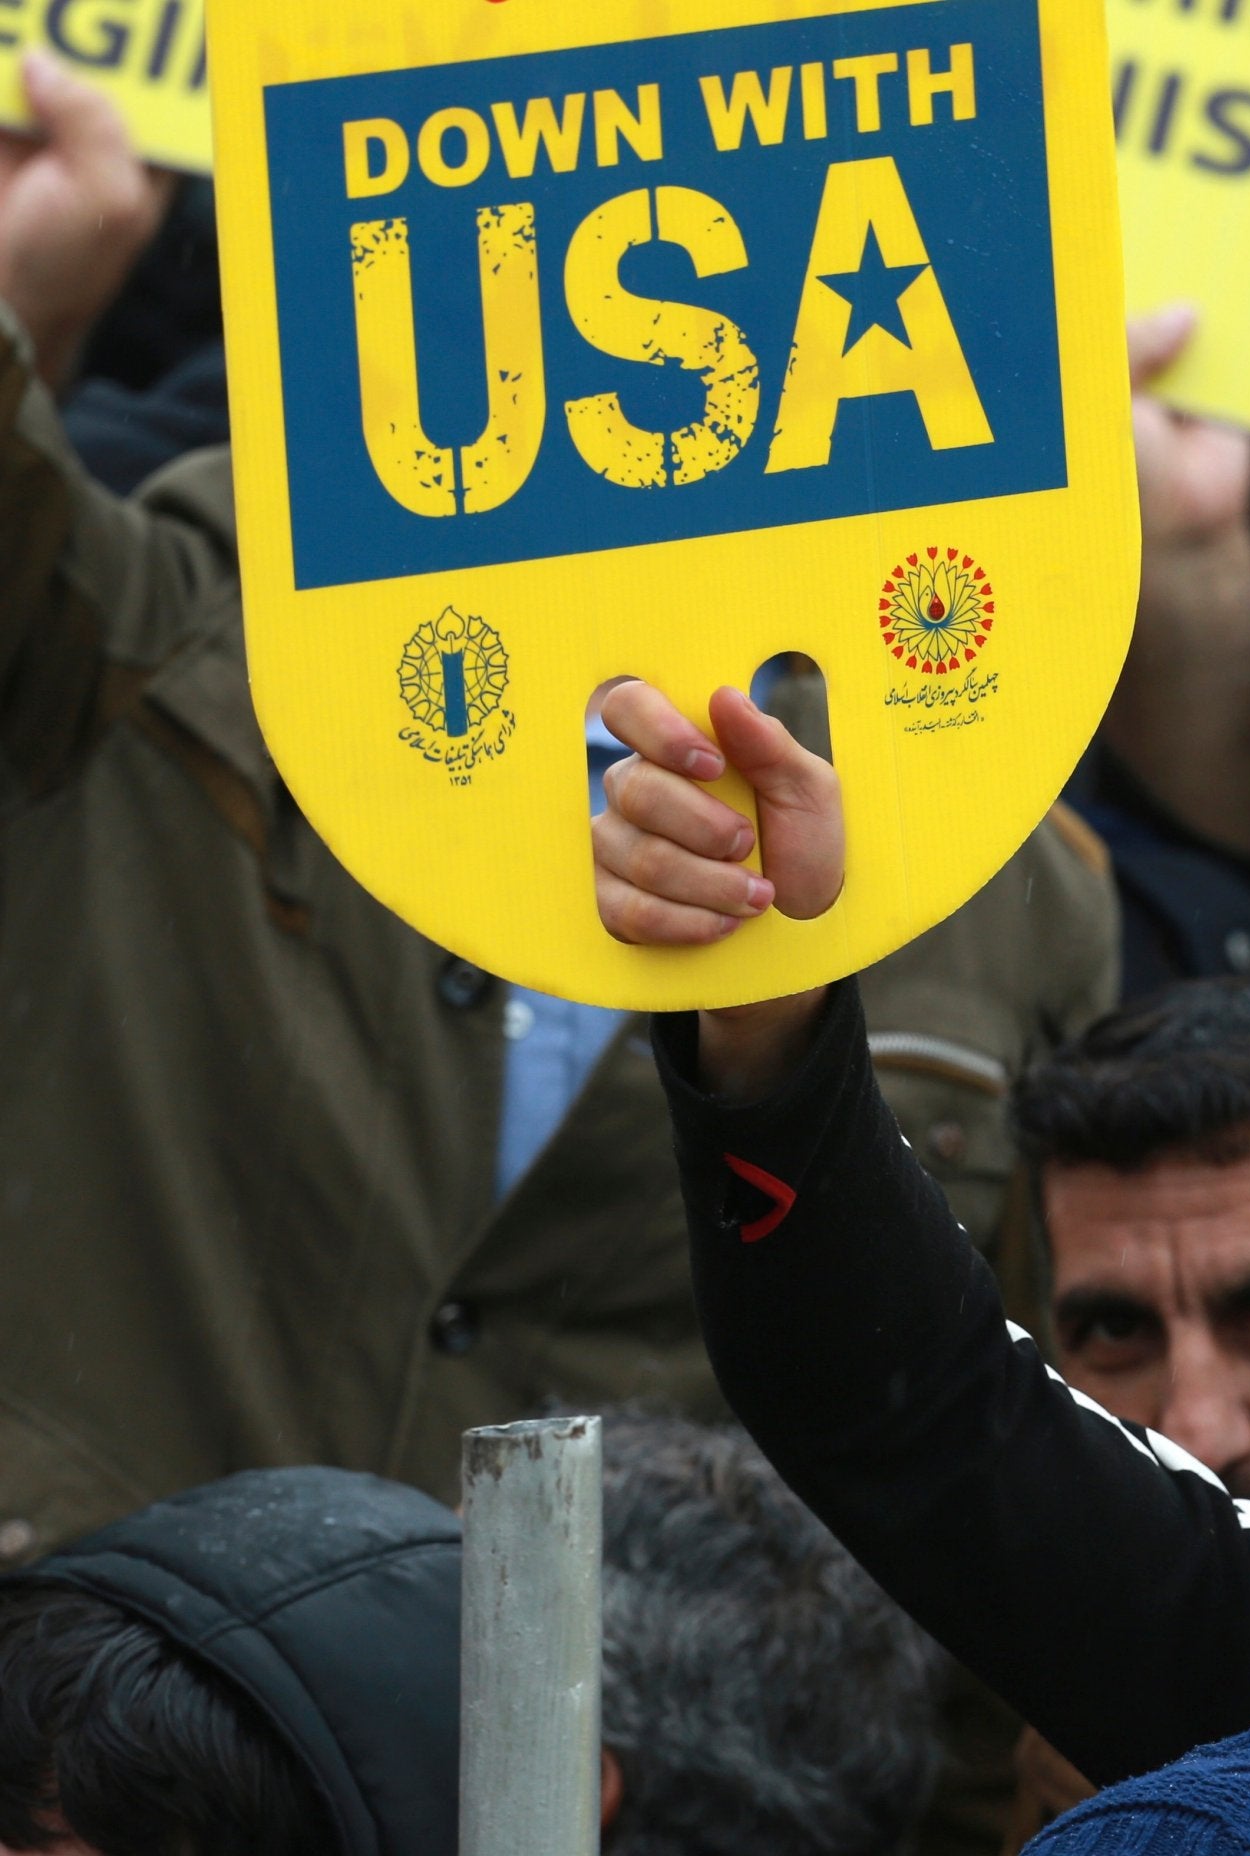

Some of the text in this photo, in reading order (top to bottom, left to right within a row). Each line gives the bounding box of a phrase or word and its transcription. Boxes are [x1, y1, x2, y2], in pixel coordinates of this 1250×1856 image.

[342, 42, 977, 199] DOWN WITH
[349, 155, 995, 519] USA
[398, 709, 516, 772] شورای هماهنگی تبلیغات اسلامی
[884, 667, 999, 708] چهلمین سالگرد پیروزی انقلاب اسلامی
